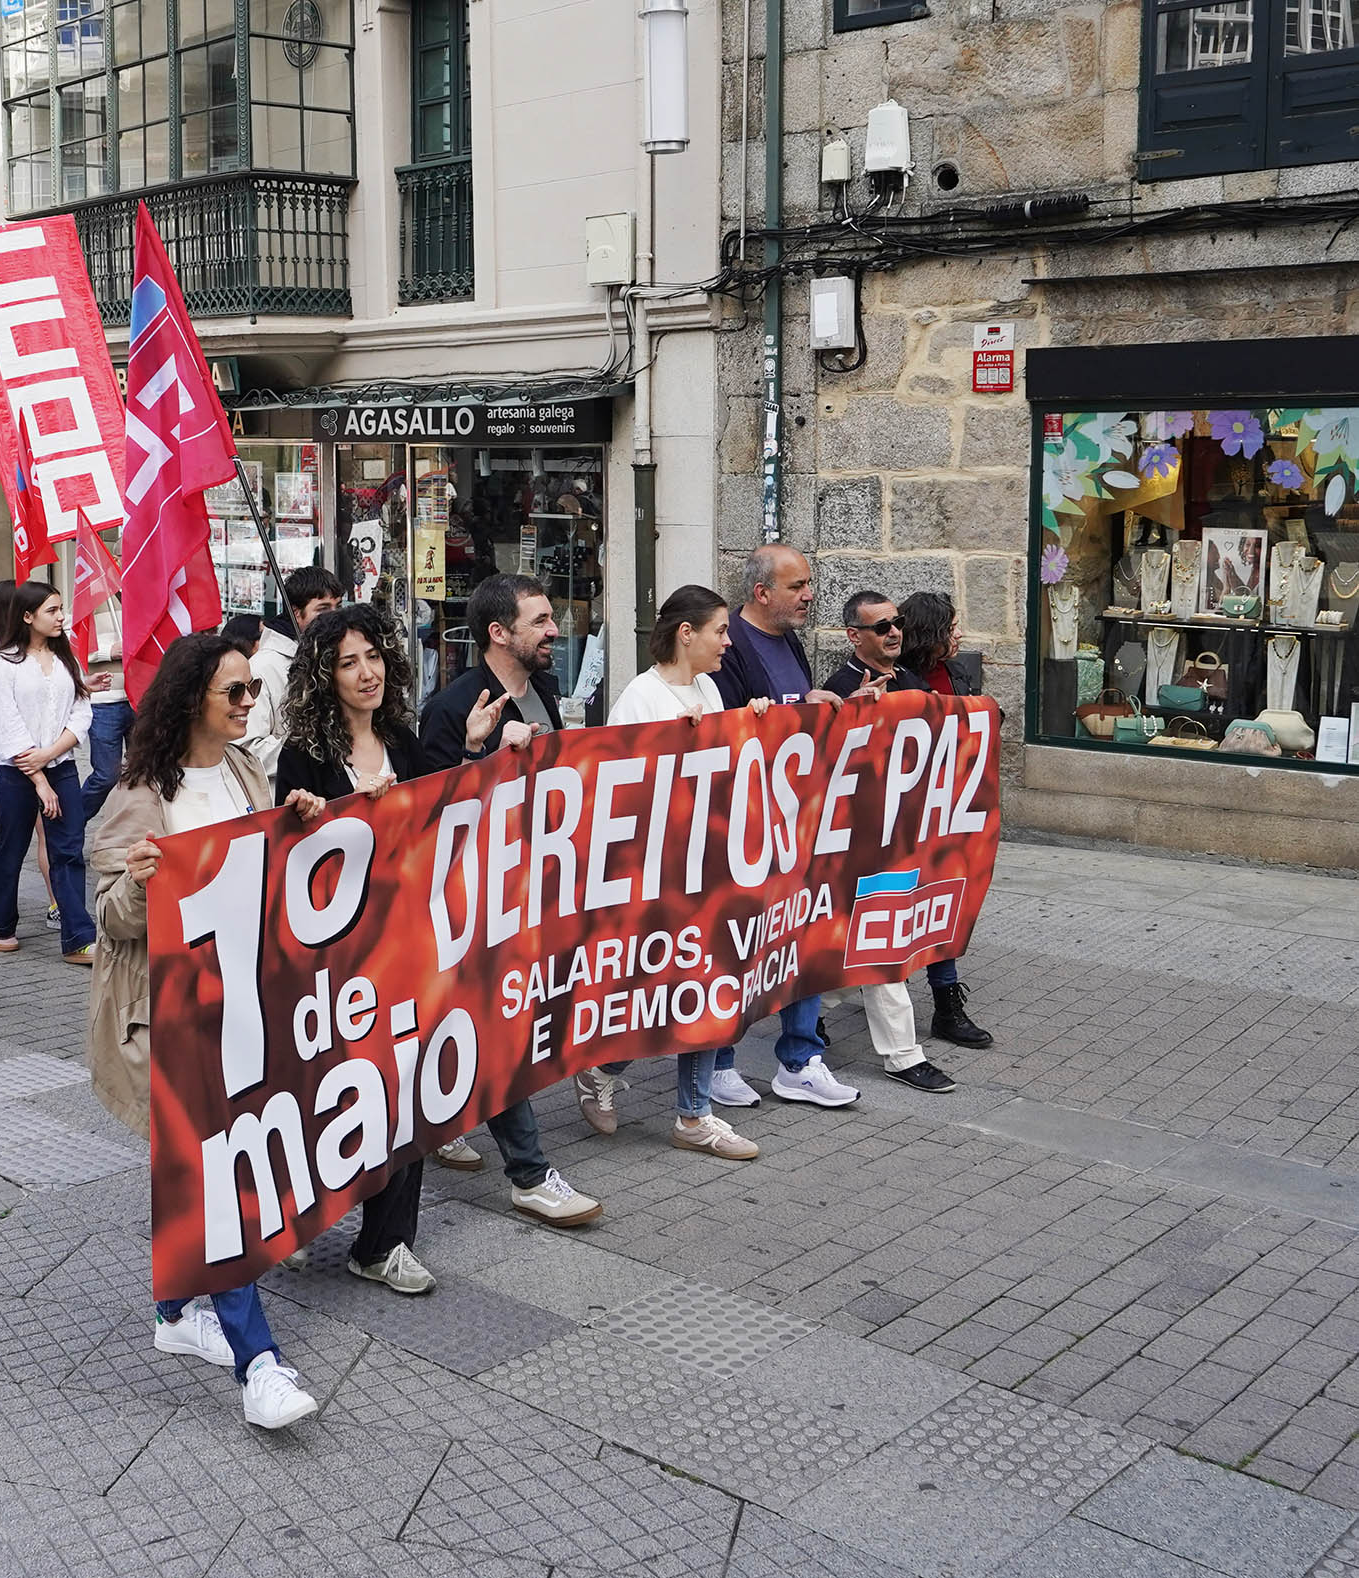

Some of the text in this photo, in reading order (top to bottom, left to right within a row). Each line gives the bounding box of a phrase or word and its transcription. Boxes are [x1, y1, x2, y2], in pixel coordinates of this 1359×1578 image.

[977, 353, 1011, 363] Alarma
[344, 406, 475, 436] AGASALLO
[487, 422, 576, 437] regalo souvenirs
[539, 404, 575, 422] galega
[429, 711, 990, 973] DEREITOS E PAZ
[501, 882, 834, 1020] SALARIOS, VIVENDA
[856, 893, 955, 952] CCOO
[293, 968, 378, 1062] de
[531, 944, 800, 1065] E DEMOCRACIA
[201, 998, 479, 1265] maio
